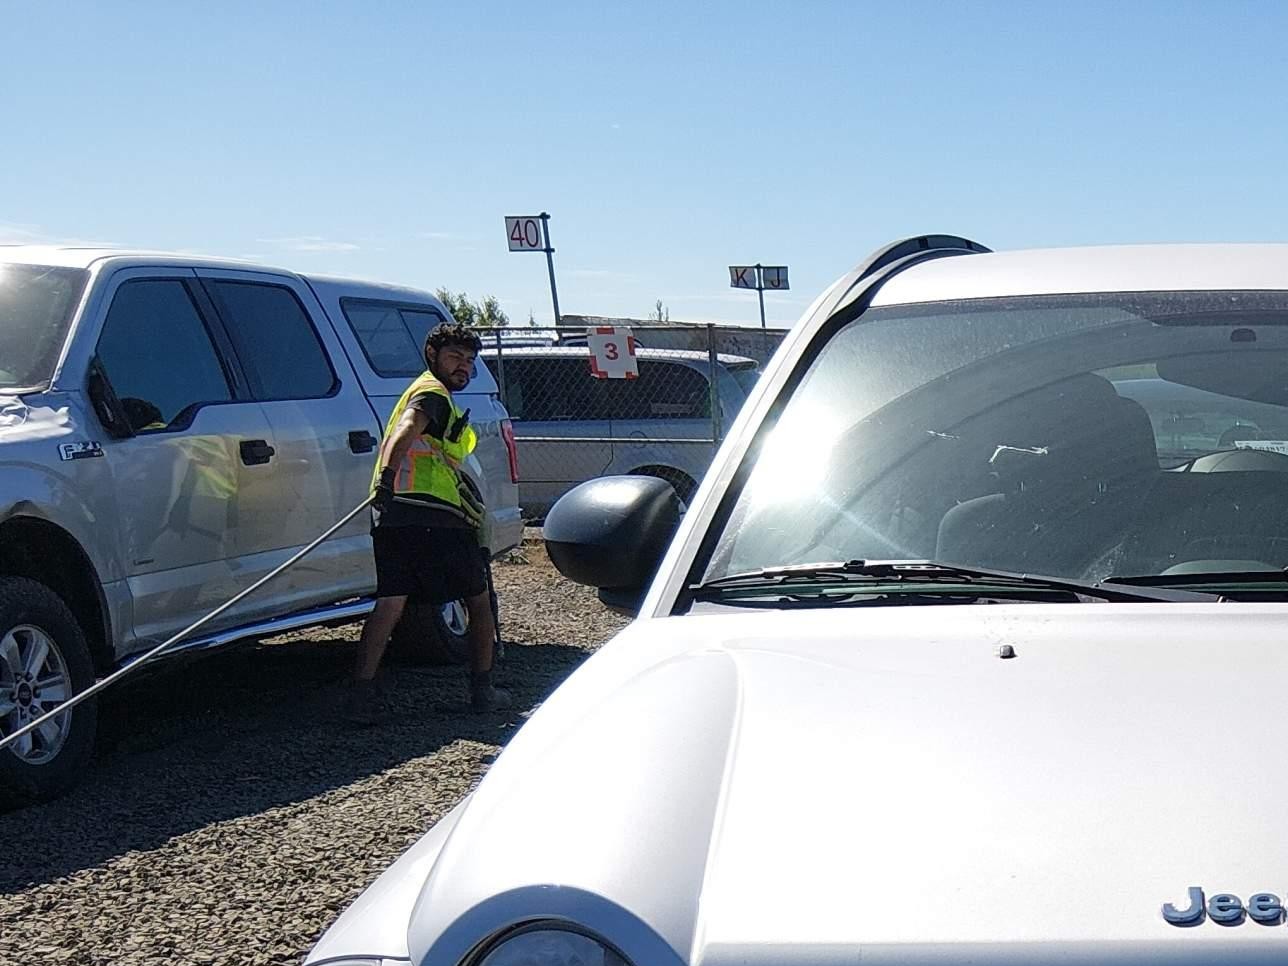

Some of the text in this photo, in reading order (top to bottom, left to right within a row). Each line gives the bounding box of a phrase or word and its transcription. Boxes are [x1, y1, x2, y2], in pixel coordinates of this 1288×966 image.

[510, 219, 539, 248] 40
[734, 268, 748, 286] K
[770, 268, 781, 288] J
[604, 342, 619, 361] 3
